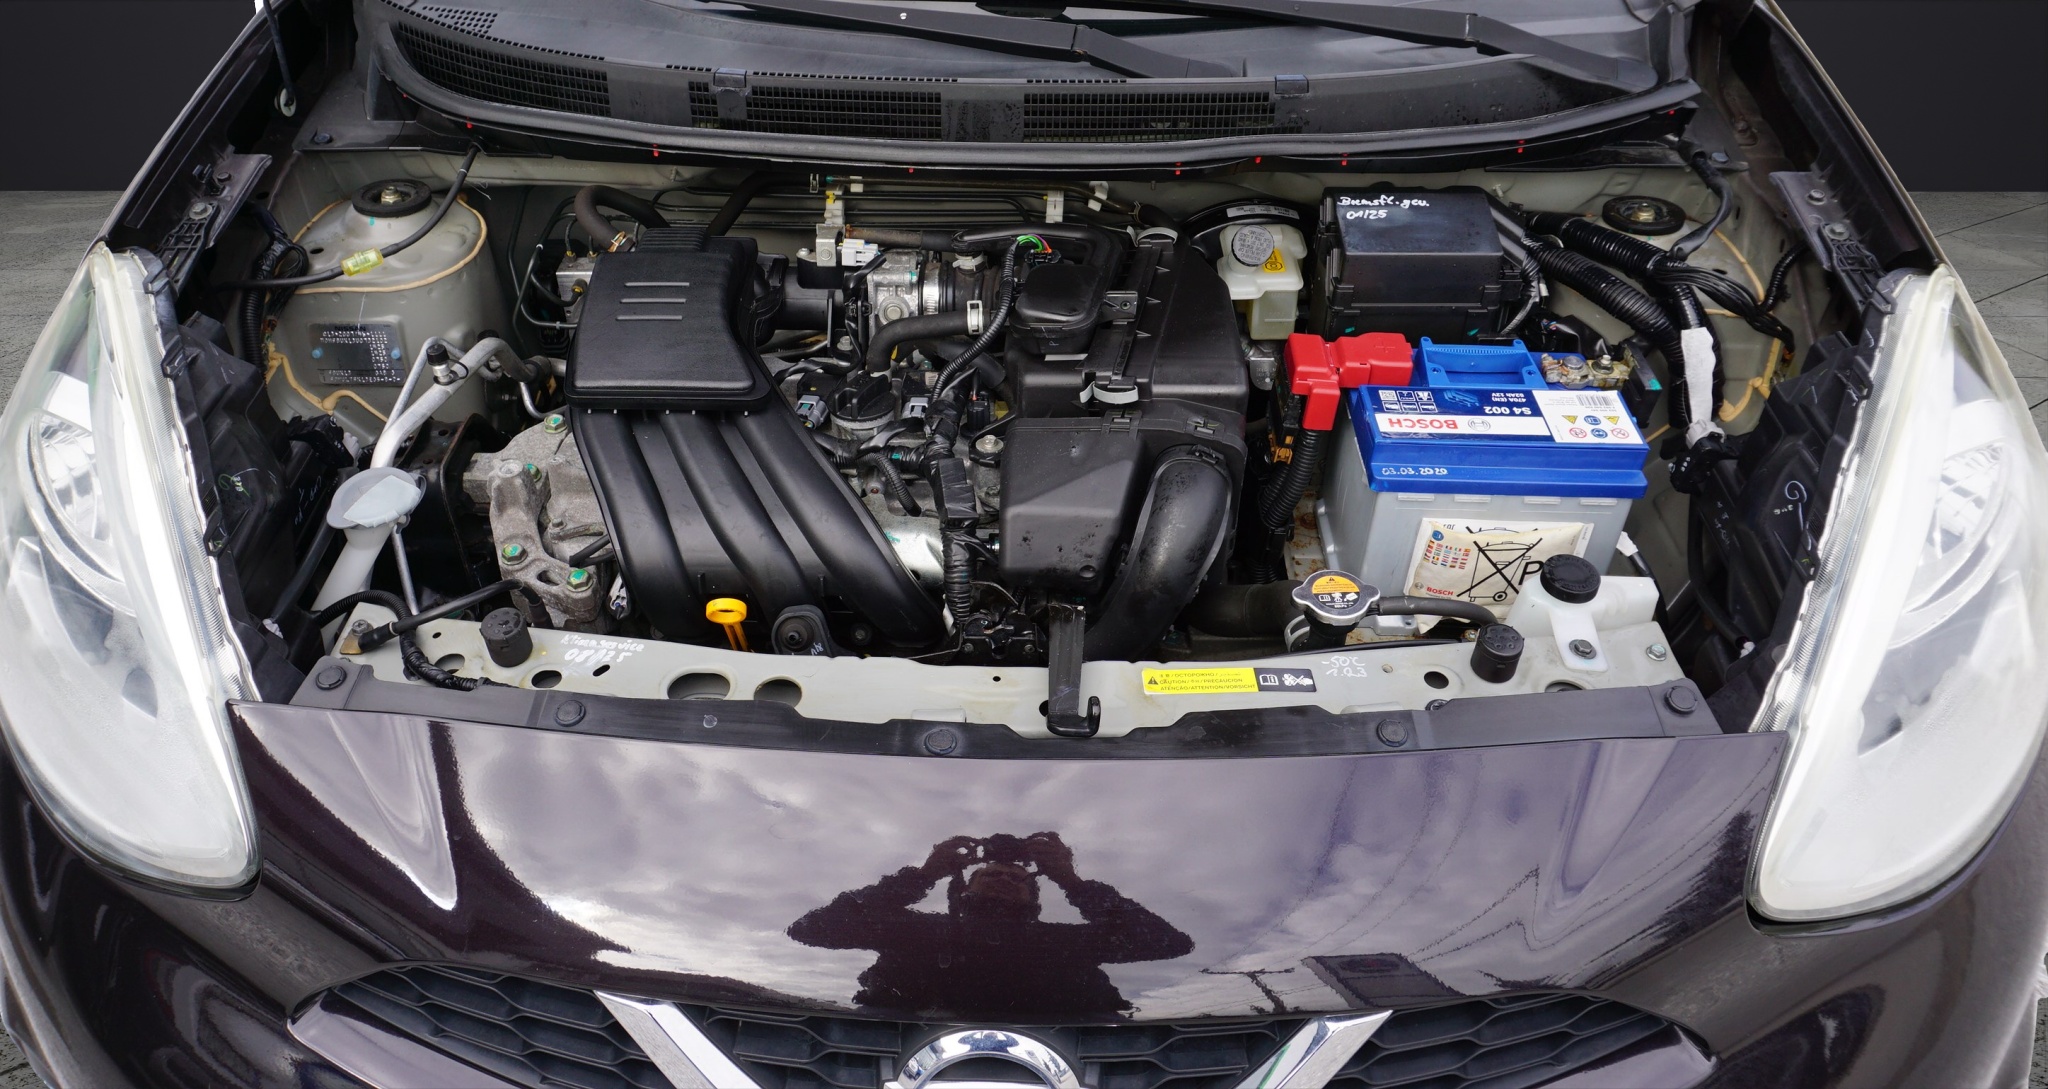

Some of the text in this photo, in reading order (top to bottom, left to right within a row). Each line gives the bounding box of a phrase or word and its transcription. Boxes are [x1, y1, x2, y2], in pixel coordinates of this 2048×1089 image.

[1483, 405, 1532, 415] S4 002
[1388, 417, 1458, 430] BOSCH
[1381, 466, 1448, 476] 03.03.2020
[1426, 586, 1454, 596] BOSCH
